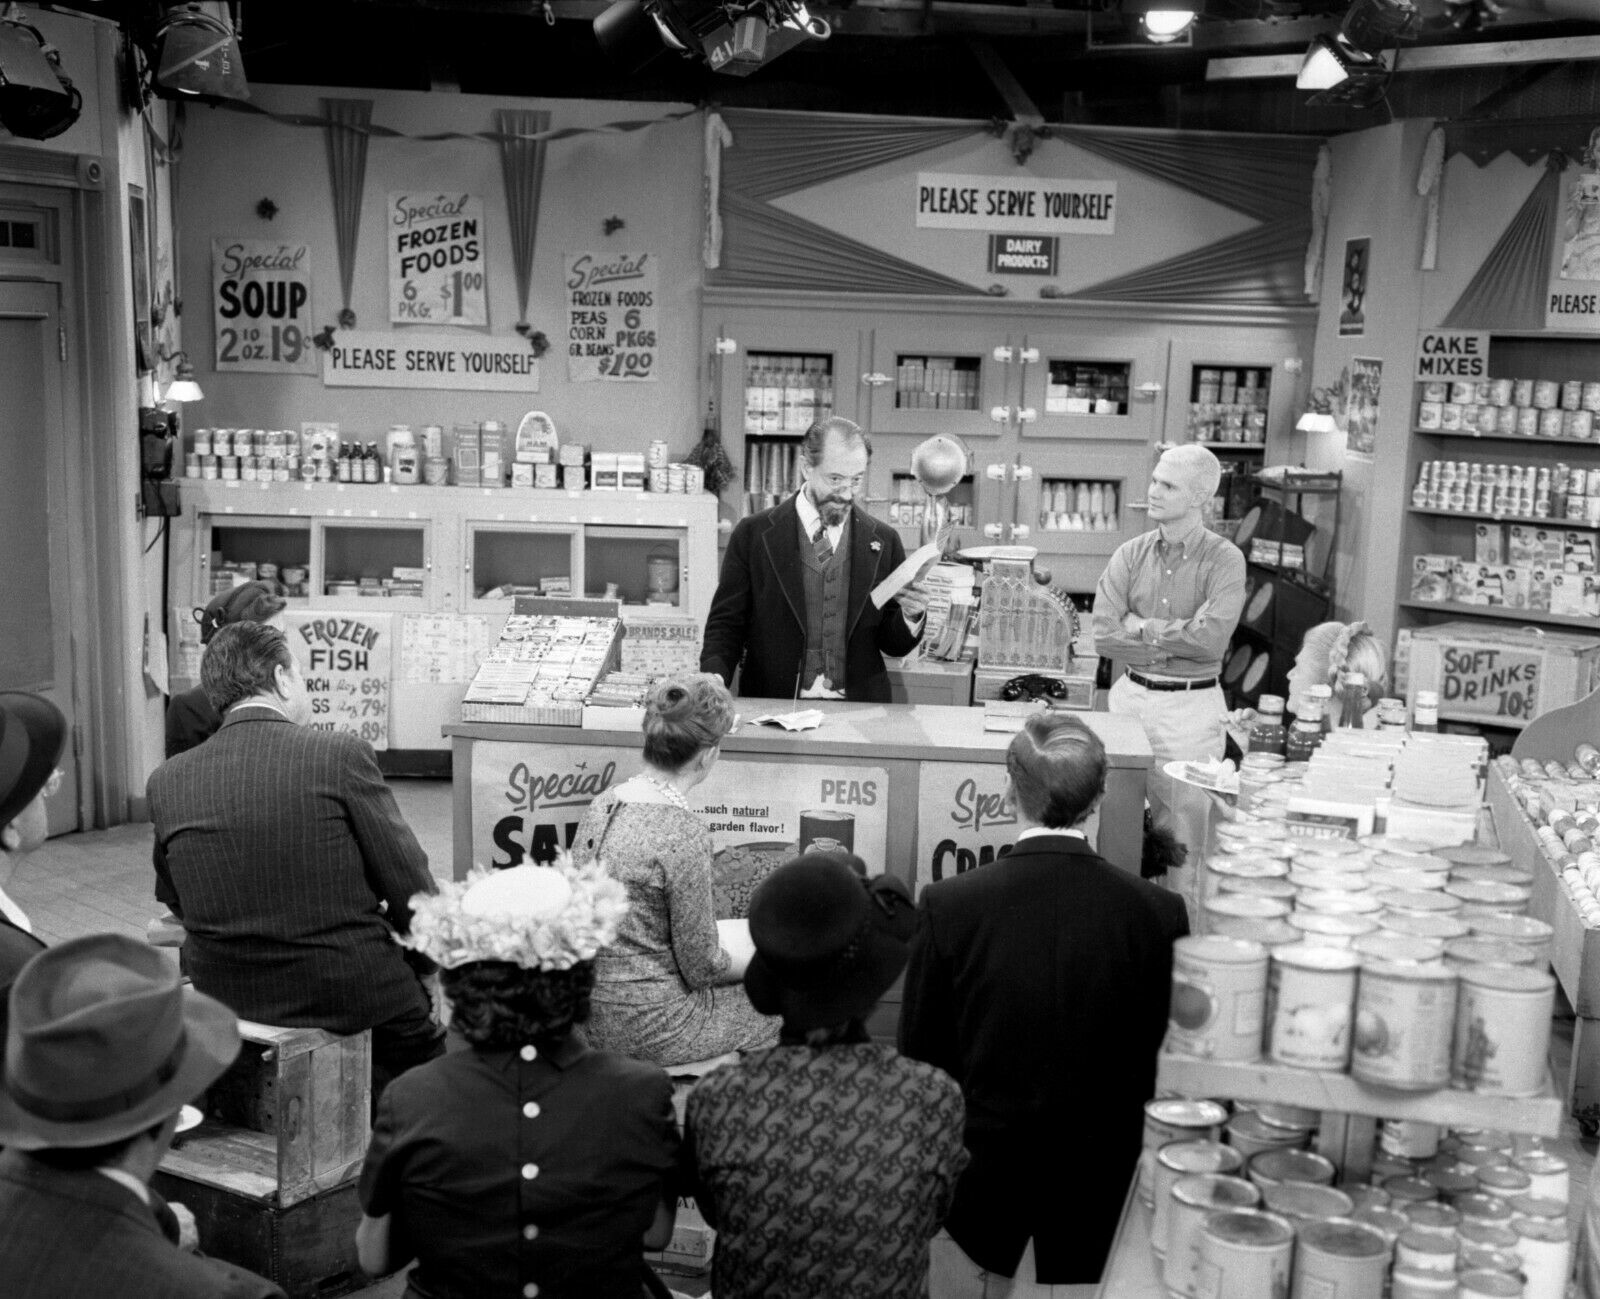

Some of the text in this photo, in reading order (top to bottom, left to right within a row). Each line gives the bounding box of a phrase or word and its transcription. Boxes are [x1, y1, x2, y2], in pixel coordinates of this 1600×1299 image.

[393, 193, 469, 229] Special
[919, 186, 1114, 221] PLEASE SERVE YOURSELF
[397, 219, 477, 253] FROZEN
[1006, 239, 1043, 254] DAIRY
[221, 243, 306, 280] Special
[401, 240, 479, 279] FOODS
[997, 253, 1049, 269] PRODUCTS
[567, 253, 648, 290] Special
[219, 279, 307, 319] SOUP
[403, 280, 417, 301] 6
[572, 291, 653, 307] FROZEN FOODS
[1550, 294, 1597, 314] PLEASE
[570, 308, 641, 330] PEAS 6
[219, 327, 240, 362] 2
[569, 326, 656, 348] CORN PKGS
[1422, 335, 1478, 354] CAKE
[332, 347, 535, 375] PLEASE SERVE YOURSELF
[586, 343, 615, 357] BEANS
[1419, 357, 1483, 376] MIXES
[299, 618, 380, 651] FROZEN
[310, 649, 368, 671] FISH
[1444, 647, 1500, 674] SOFT
[304, 678, 330, 692] RCH
[1443, 663, 1536, 701] DRINKS
[308, 722, 336, 732] OUT
[505, 761, 616, 812] Special
[820, 779, 877, 806] PEAS
[732, 805, 769, 817] natural
[710, 822, 745, 833] garden
